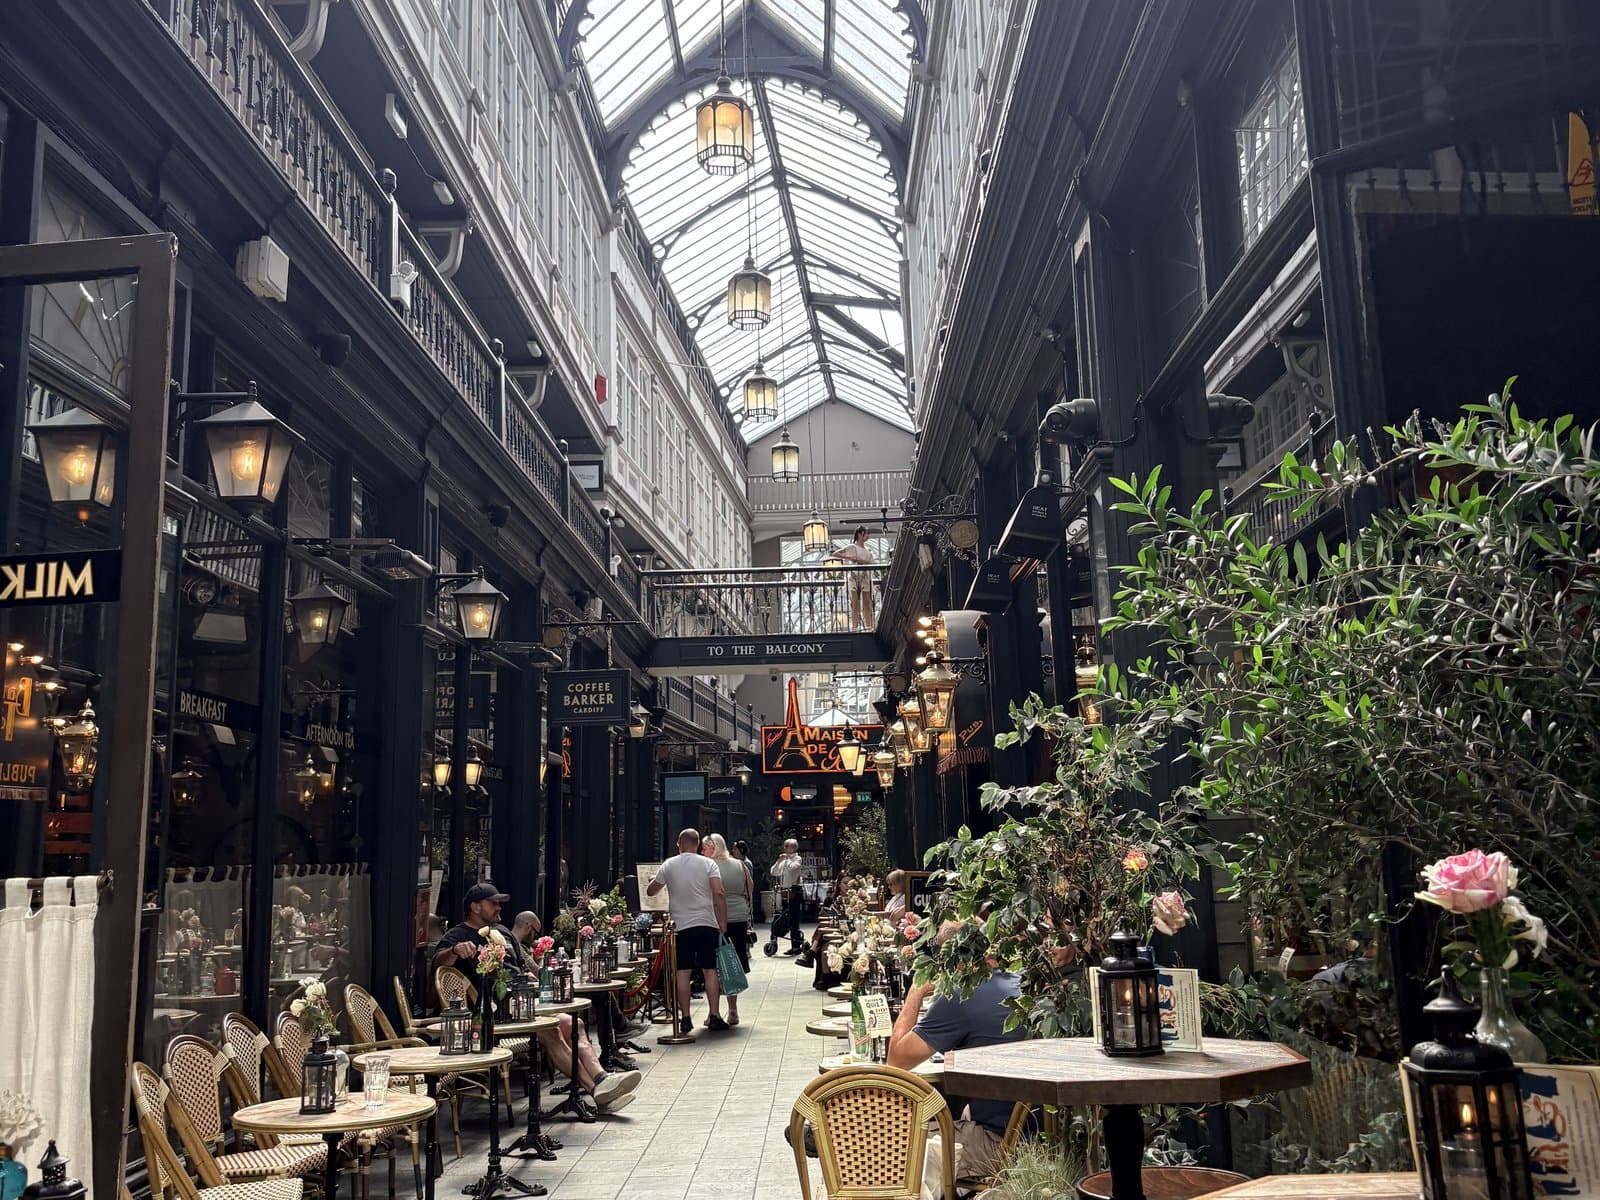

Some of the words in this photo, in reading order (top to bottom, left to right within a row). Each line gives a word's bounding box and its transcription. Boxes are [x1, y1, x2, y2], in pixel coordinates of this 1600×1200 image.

[707, 646, 724, 656] TO
[731, 645, 756, 655] THE
[765, 643, 825, 655] BALCONY
[567, 682, 611, 693] COFFEE
[563, 693, 615, 706] BARKER
[180, 690, 228, 723] BREAKFAST
[573, 706, 604, 714] CARDIFF
[305, 722, 344, 747] AFTERNOON
[804, 727, 868, 742] MAISN
[807, 743, 828, 755] DE
